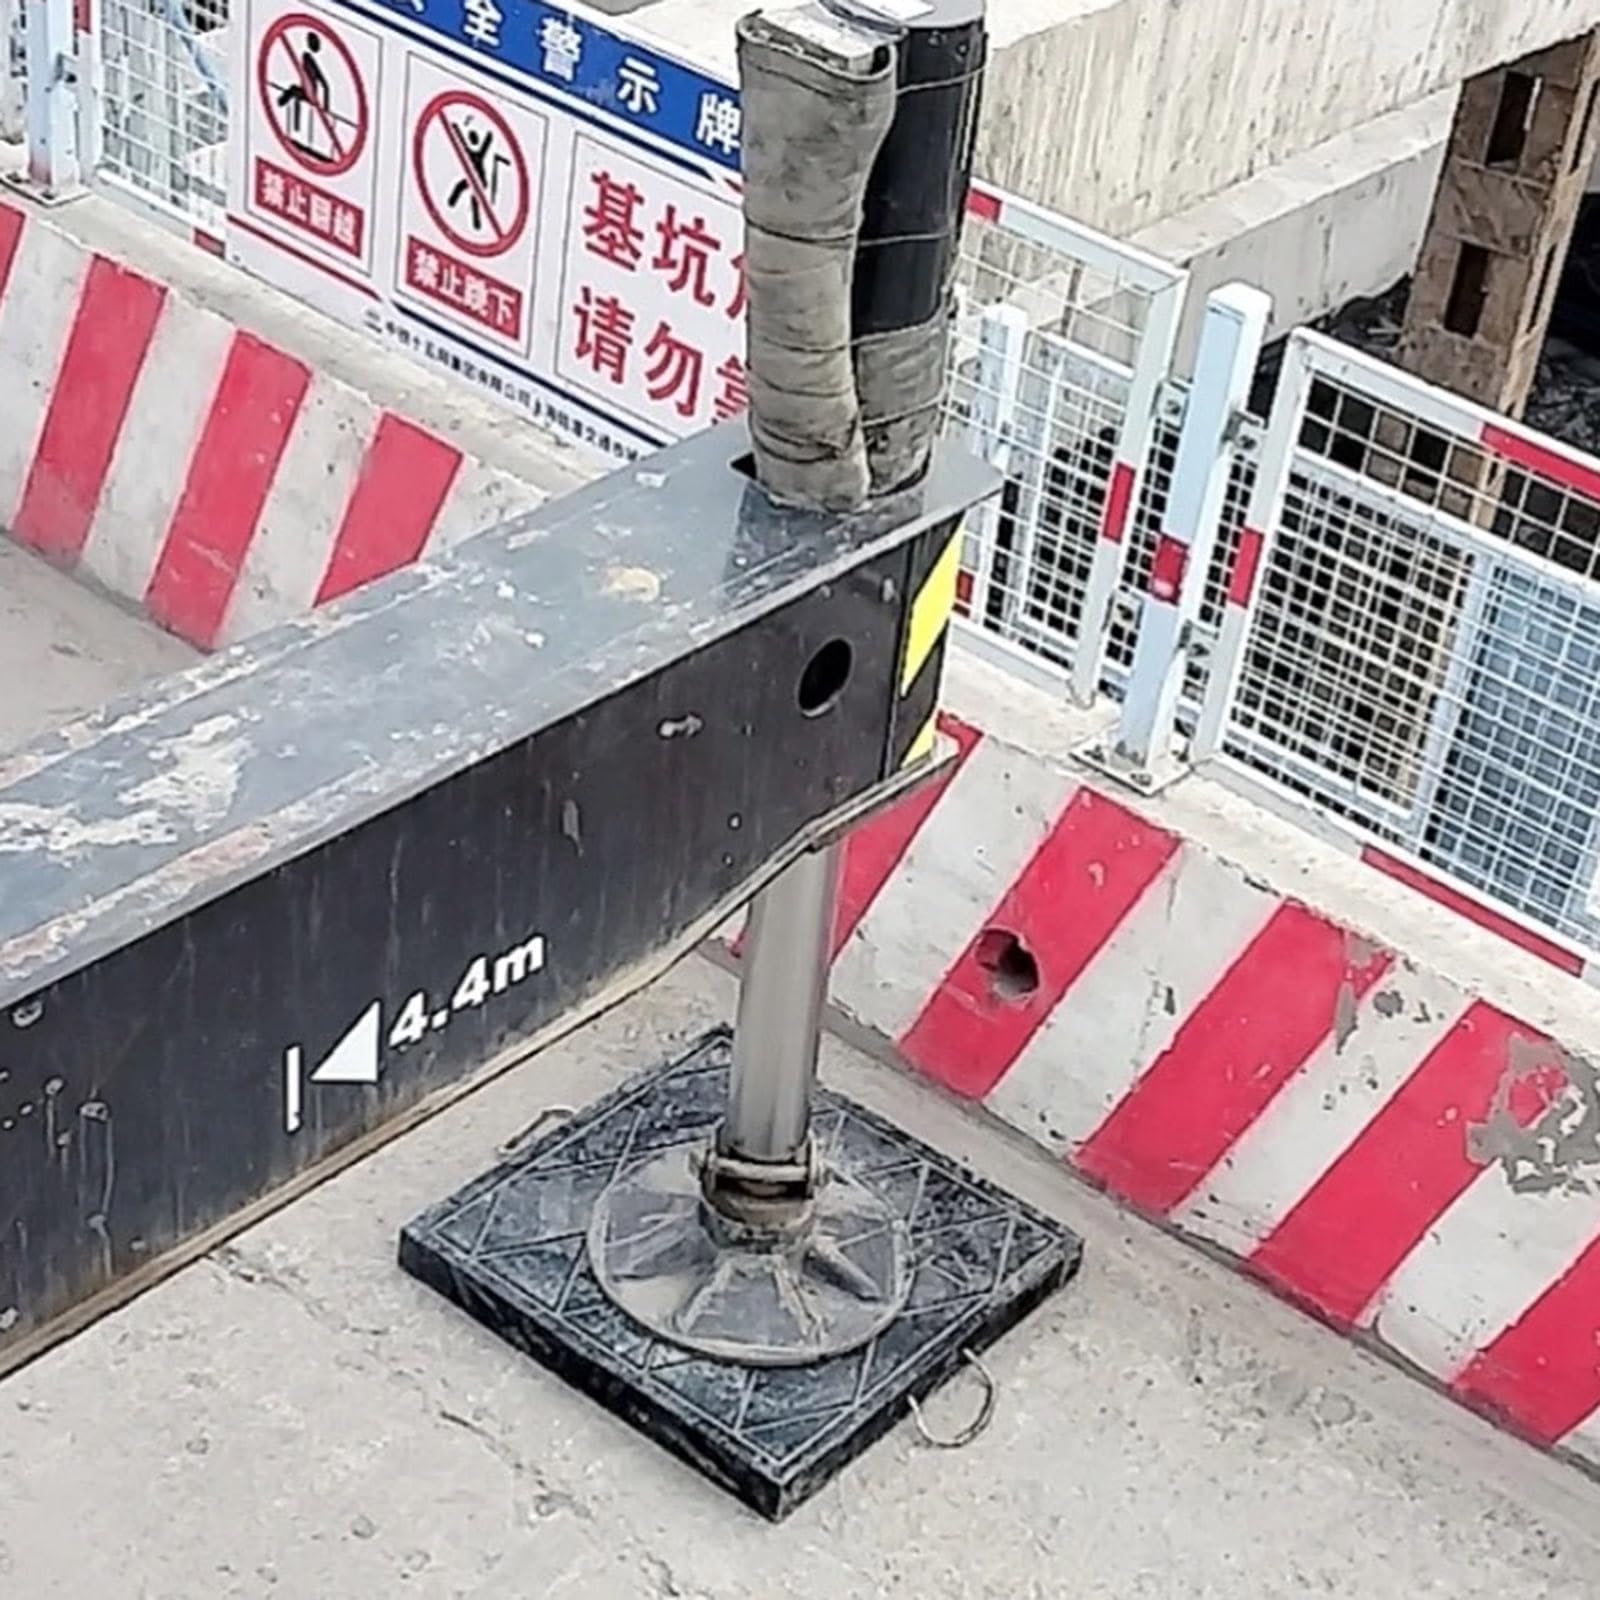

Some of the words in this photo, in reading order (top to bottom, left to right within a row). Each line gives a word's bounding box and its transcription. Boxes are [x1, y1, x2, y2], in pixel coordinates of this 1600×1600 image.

[410, 0, 742, 154] 全警示牌
[582, 171, 746, 320] 基坑
[388, 934, 545, 1047] 4.4m
